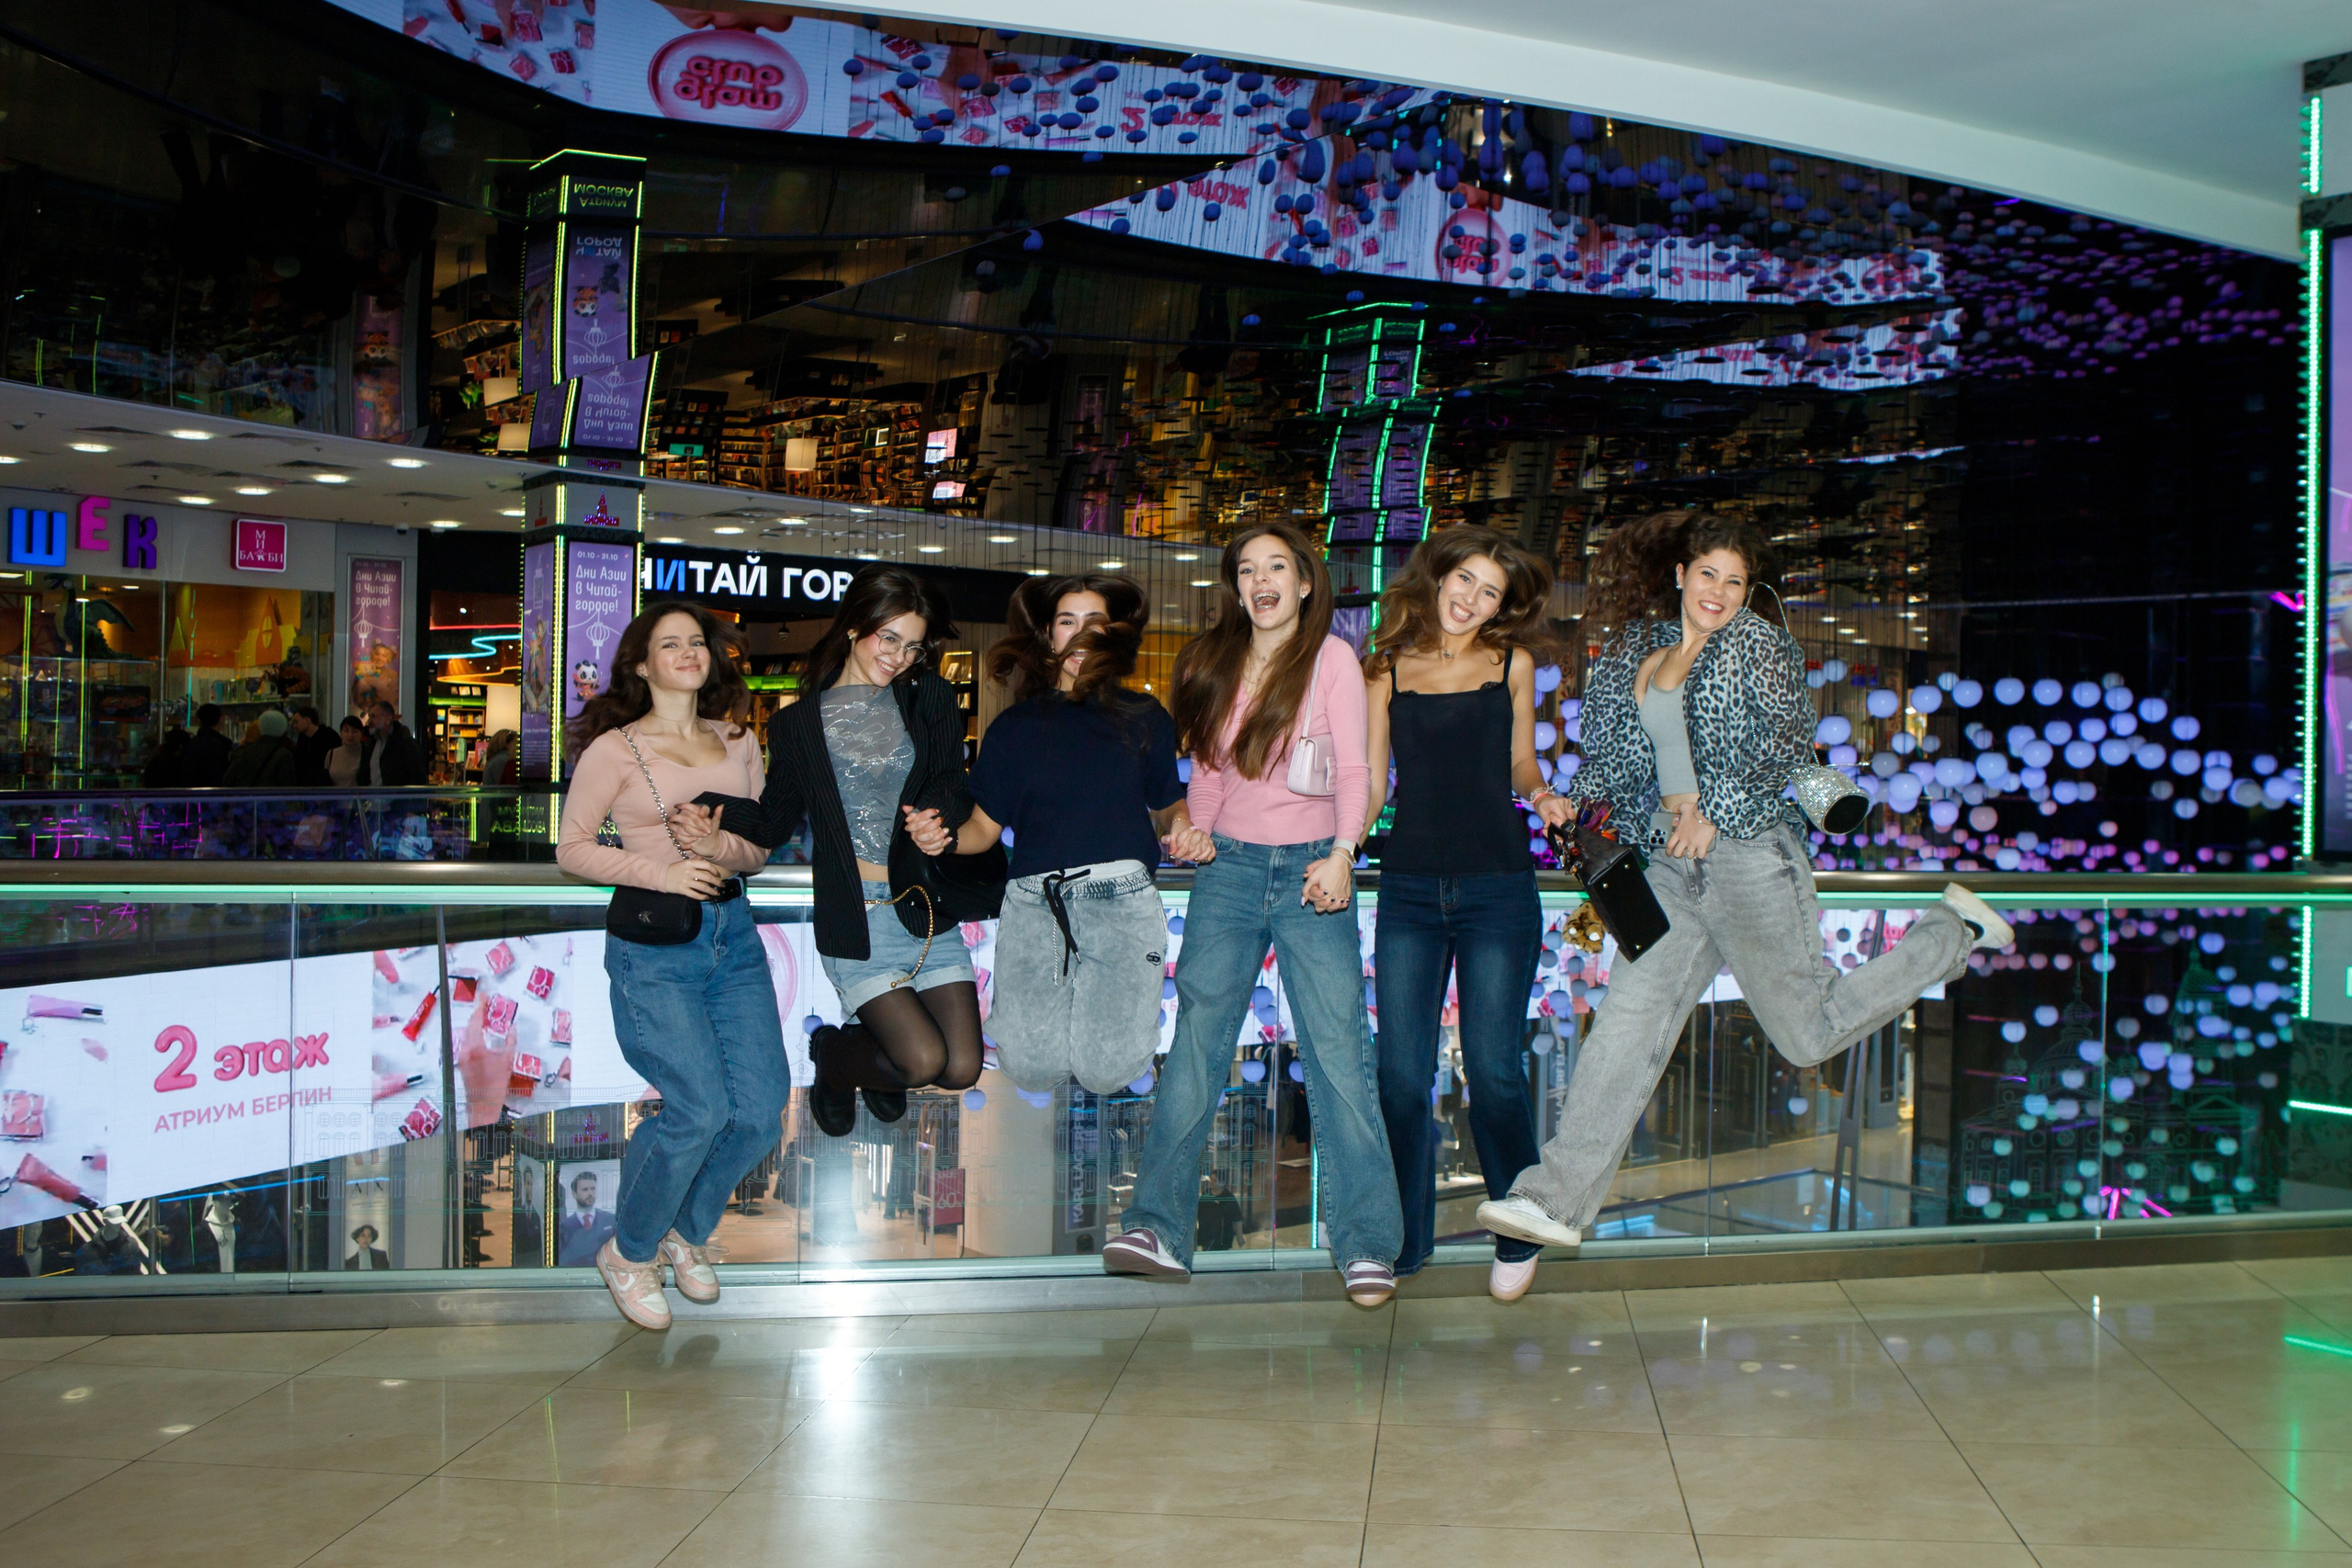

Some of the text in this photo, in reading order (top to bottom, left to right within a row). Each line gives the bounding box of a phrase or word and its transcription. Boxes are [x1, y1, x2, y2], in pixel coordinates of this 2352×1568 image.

[577, 550, 595, 559] 01.10
[601, 553, 618, 561] 31.10
[356, 570, 397, 581] Дни Азии
[575, 564, 627, 581] Дни Азии
[586, 582, 623, 597] Читай-
[575, 599, 618, 615] городе!
[153, 1024, 330, 1093] 2 этаж
[153, 1100, 245, 1134] АТРИУМ
